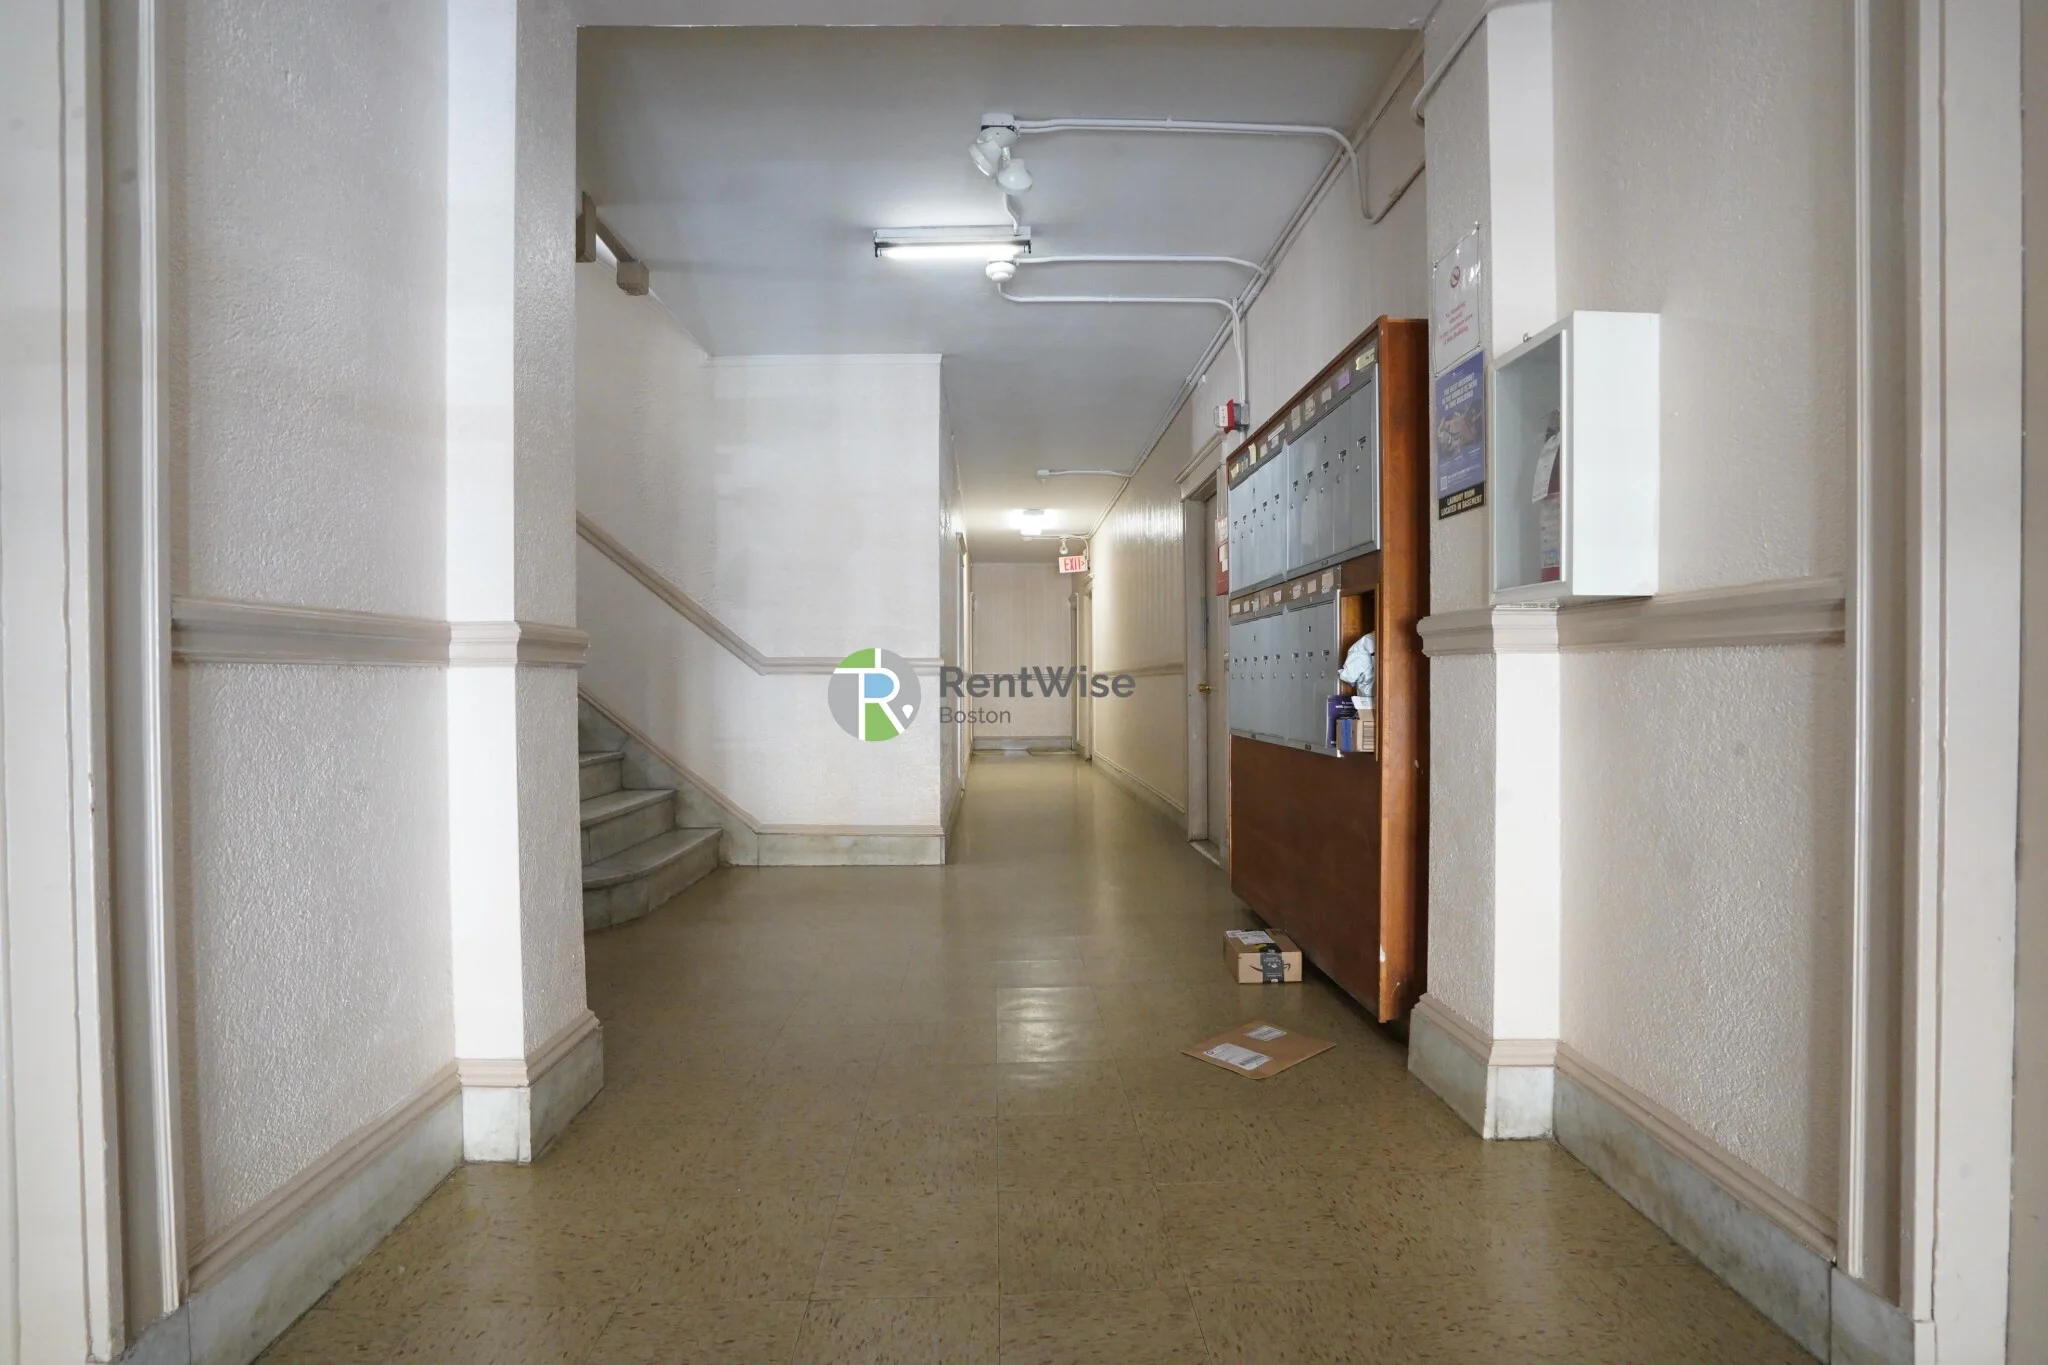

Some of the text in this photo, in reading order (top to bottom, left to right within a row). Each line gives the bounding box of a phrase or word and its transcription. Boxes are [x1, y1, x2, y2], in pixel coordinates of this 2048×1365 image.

[1447, 488, 1475, 505] LAUNDRY ROOM
[1441, 495, 1482, 516] LOCATED IN BASEMENT
[1064, 557, 1081, 571] EXIT
